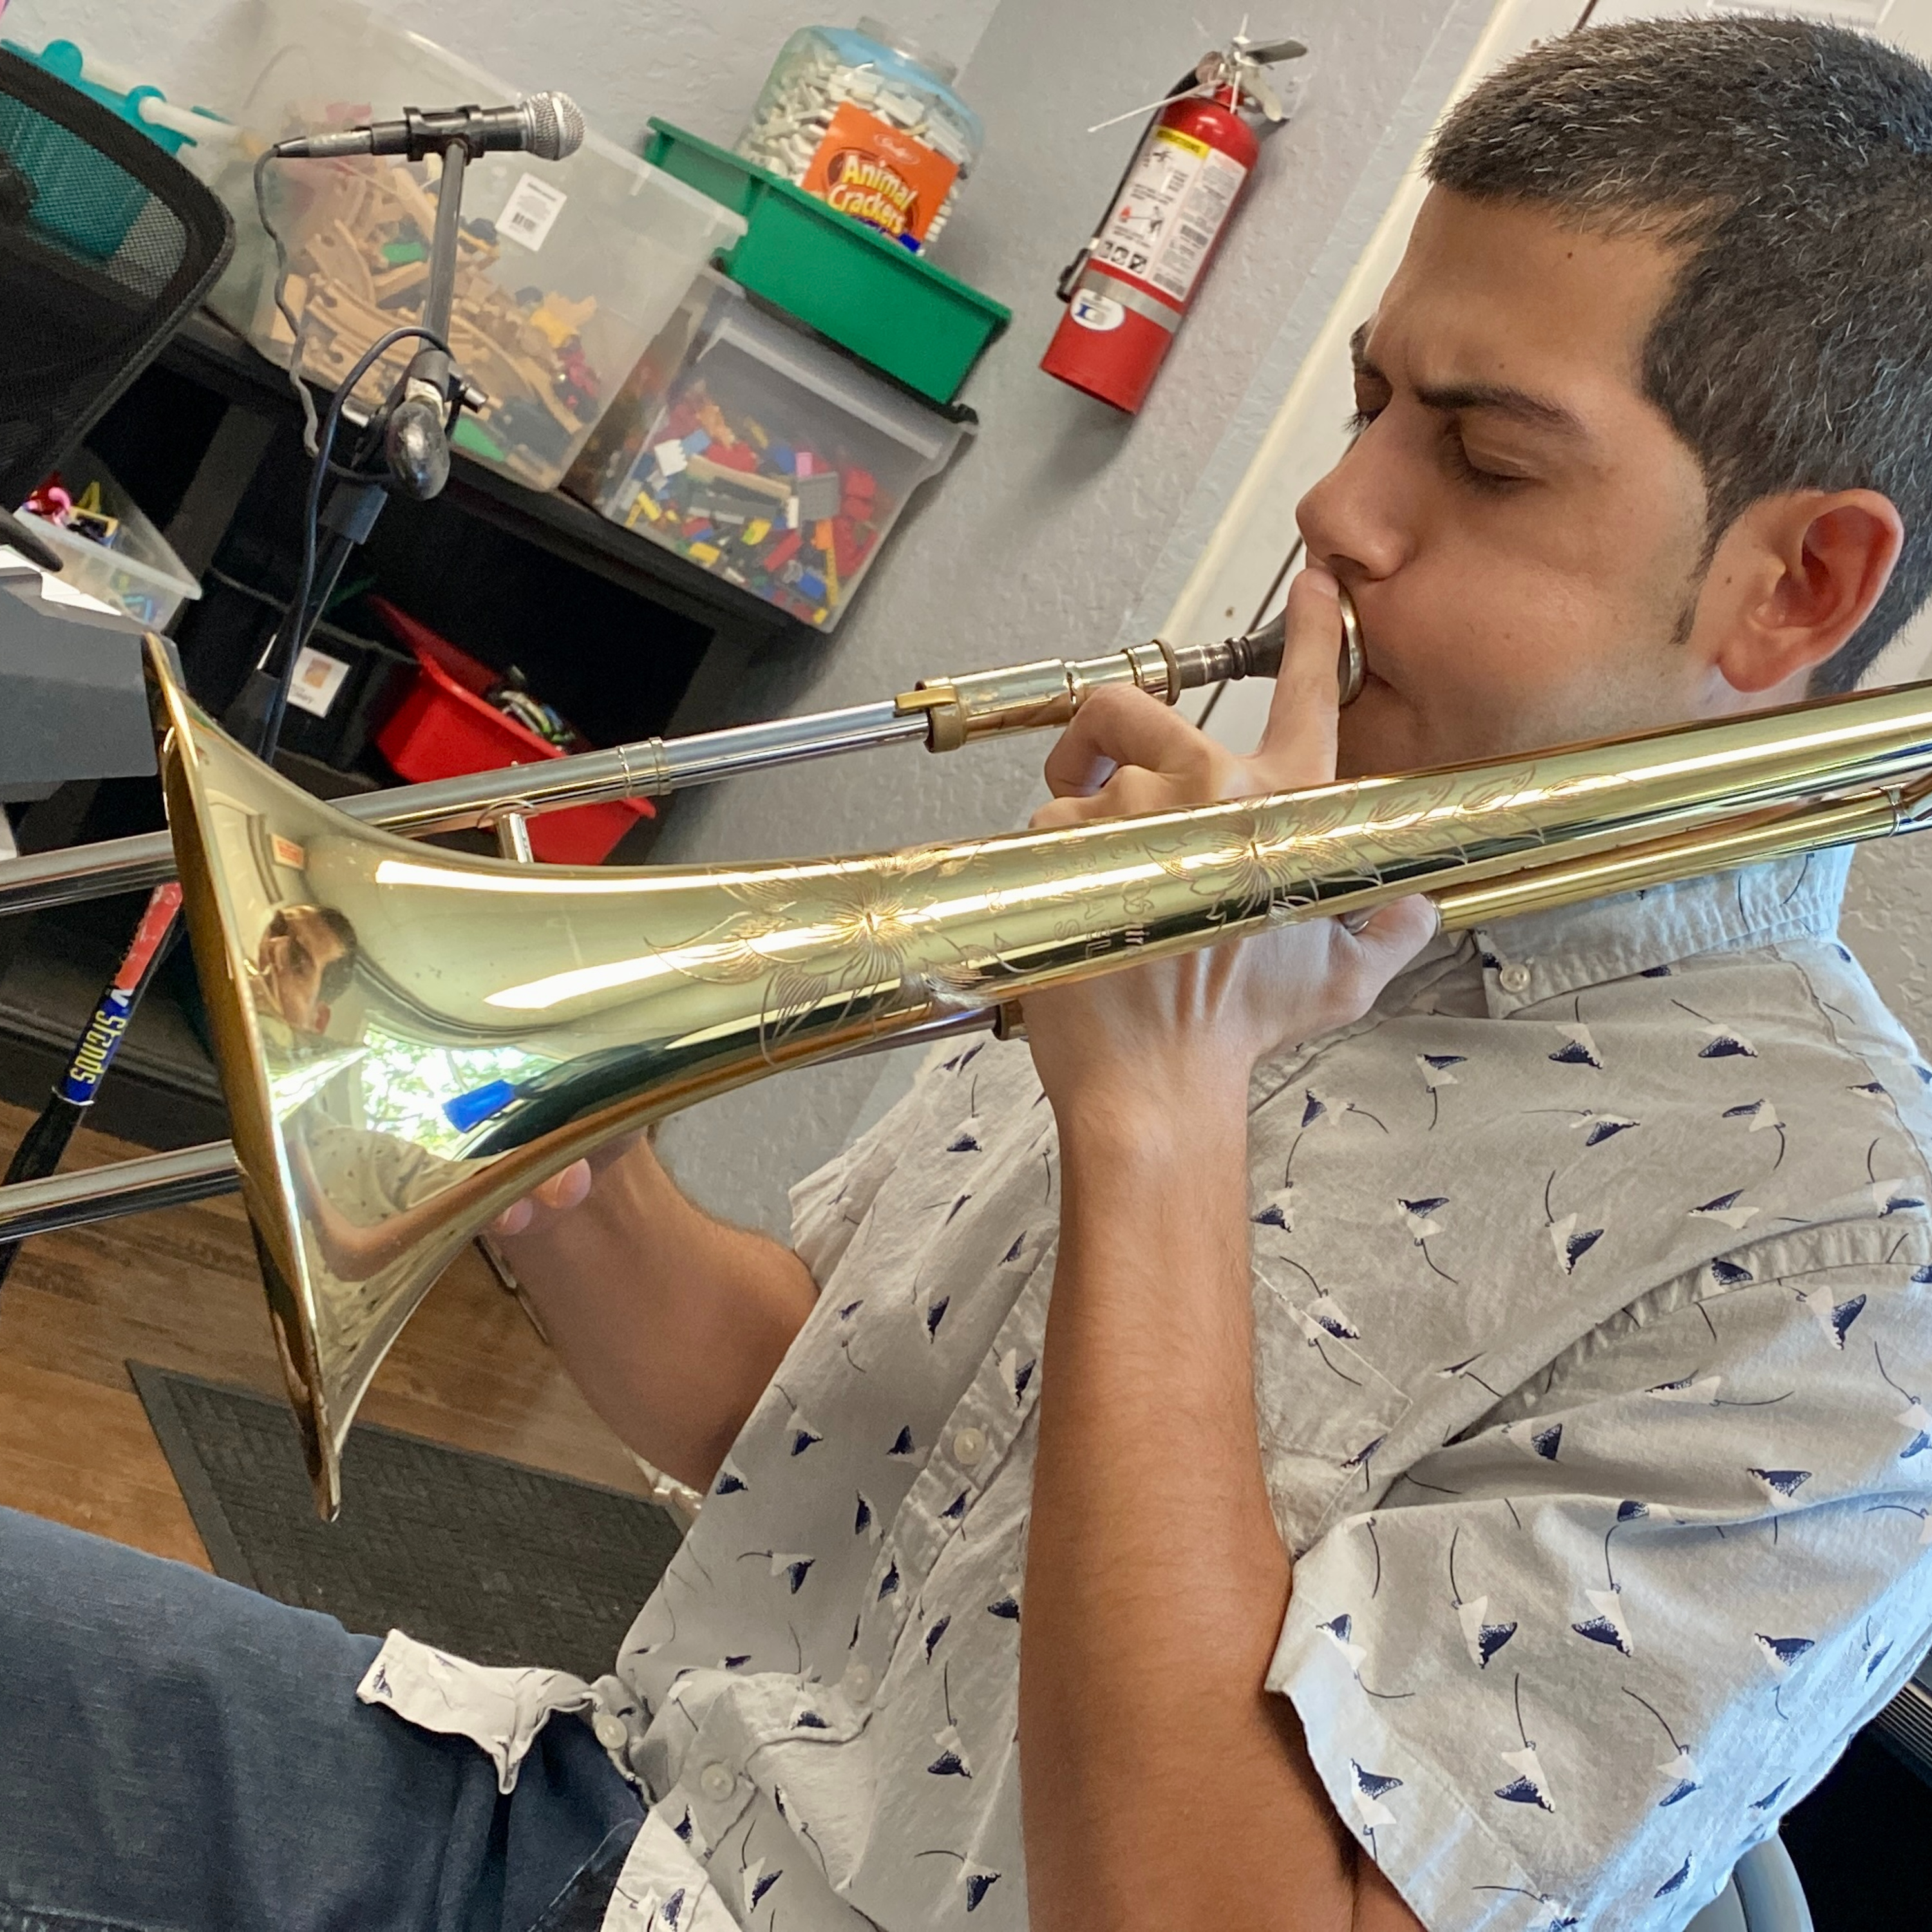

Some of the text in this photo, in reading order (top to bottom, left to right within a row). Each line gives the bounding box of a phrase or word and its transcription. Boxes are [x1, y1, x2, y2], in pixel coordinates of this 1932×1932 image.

[828, 184, 904, 234] Crackers
[842, 155, 918, 211] Animal
[70, 1010, 127, 1084] Stands
